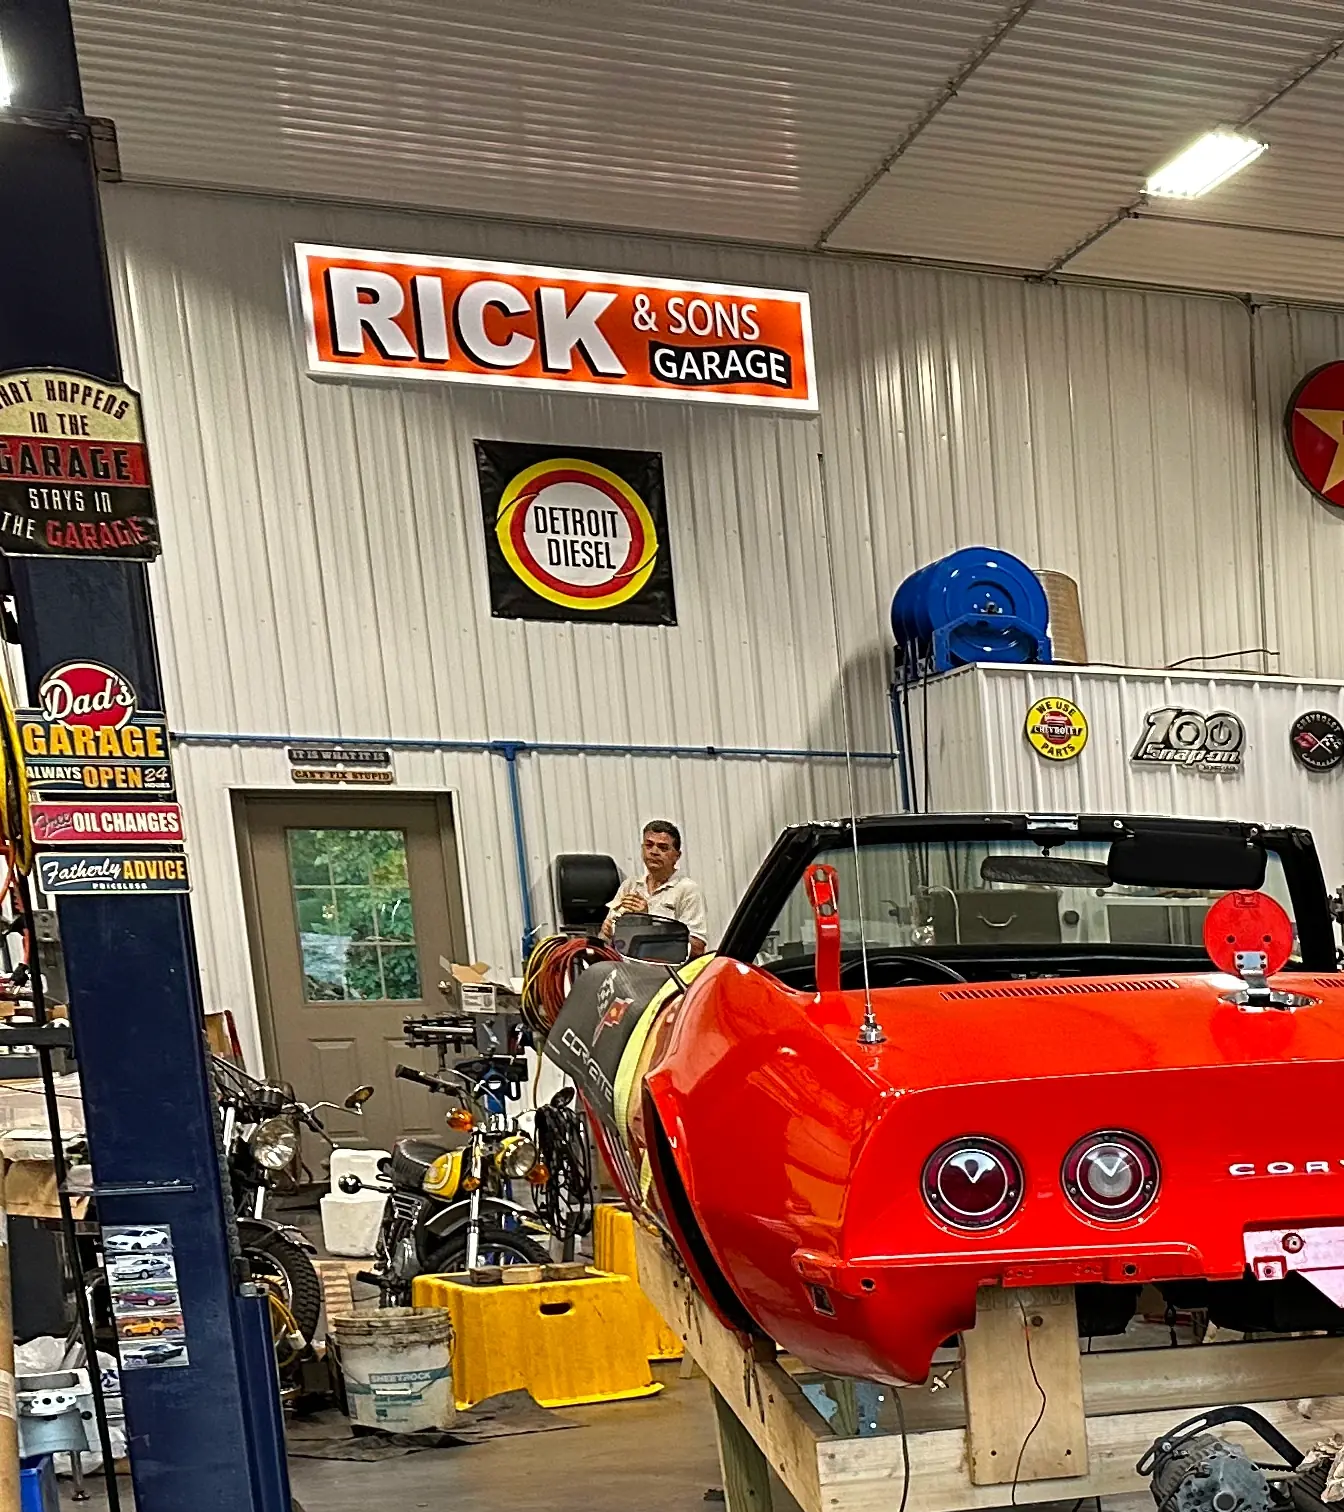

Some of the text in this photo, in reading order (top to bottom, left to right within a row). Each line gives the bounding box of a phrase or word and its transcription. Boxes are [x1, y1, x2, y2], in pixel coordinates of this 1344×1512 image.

[326, 266, 627, 378] RICK
[632, 294, 760, 341] & SONS
[654, 348, 788, 384] GARAGE
[0, 379, 130, 420] HAT HAPPENS
[29, 411, 90, 436] IN THE
[0, 442, 131, 481] GARAGE
[28, 488, 112, 513] STAYS IN
[0, 511, 150, 549] THE GARAGE
[533, 506, 618, 538] DETROIT
[547, 538, 616, 569] DIESEL
[40, 675, 136, 721] Dad's
[1036, 701, 1076, 716] WE USE
[22, 722, 165, 758] GARAGE
[1041, 742, 1075, 757] PARTS
[292, 750, 304, 759] IT
[307, 751, 318, 759] IS
[321, 751, 356, 760] WHAT
[359, 752, 371, 760] IT
[26, 765, 168, 789] ALWAYS OPEN 24
[330, 771, 347, 780] FIX
[352, 772, 390, 781] STUPID
[72, 811, 101, 833] OIL
[100, 812, 180, 833] CHANGES
[42, 857, 187, 885] Fatherly ADVICE
[92, 882, 148, 890] PRICELESS
